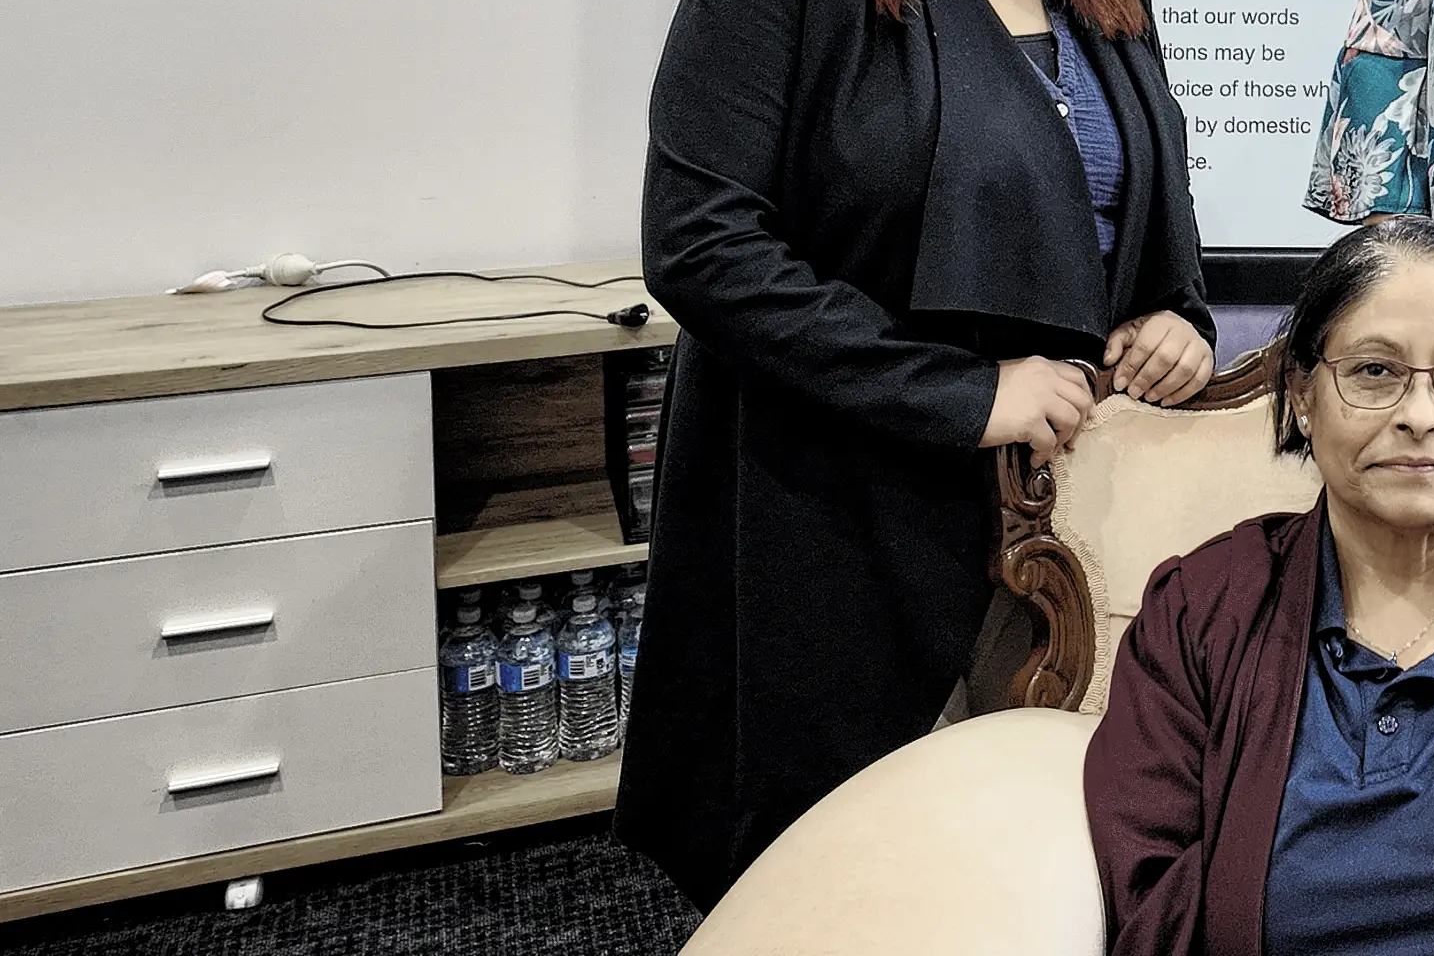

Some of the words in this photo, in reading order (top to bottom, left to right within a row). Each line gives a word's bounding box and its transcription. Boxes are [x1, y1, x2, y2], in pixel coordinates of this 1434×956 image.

[1161, 6, 1200, 25] that
[1204, 11, 1237, 25] our
[1241, 7, 1300, 26] words
[1162, 43, 1208, 61] tions
[1214, 47, 1256, 66] may
[1261, 43, 1286, 62] be
[1219, 79, 1240, 98] of
[1244, 80, 1297, 98] those
[1302, 81, 1330, 98] wh
[1195, 115, 1219, 138] by
[1223, 115, 1312, 135] domestic
